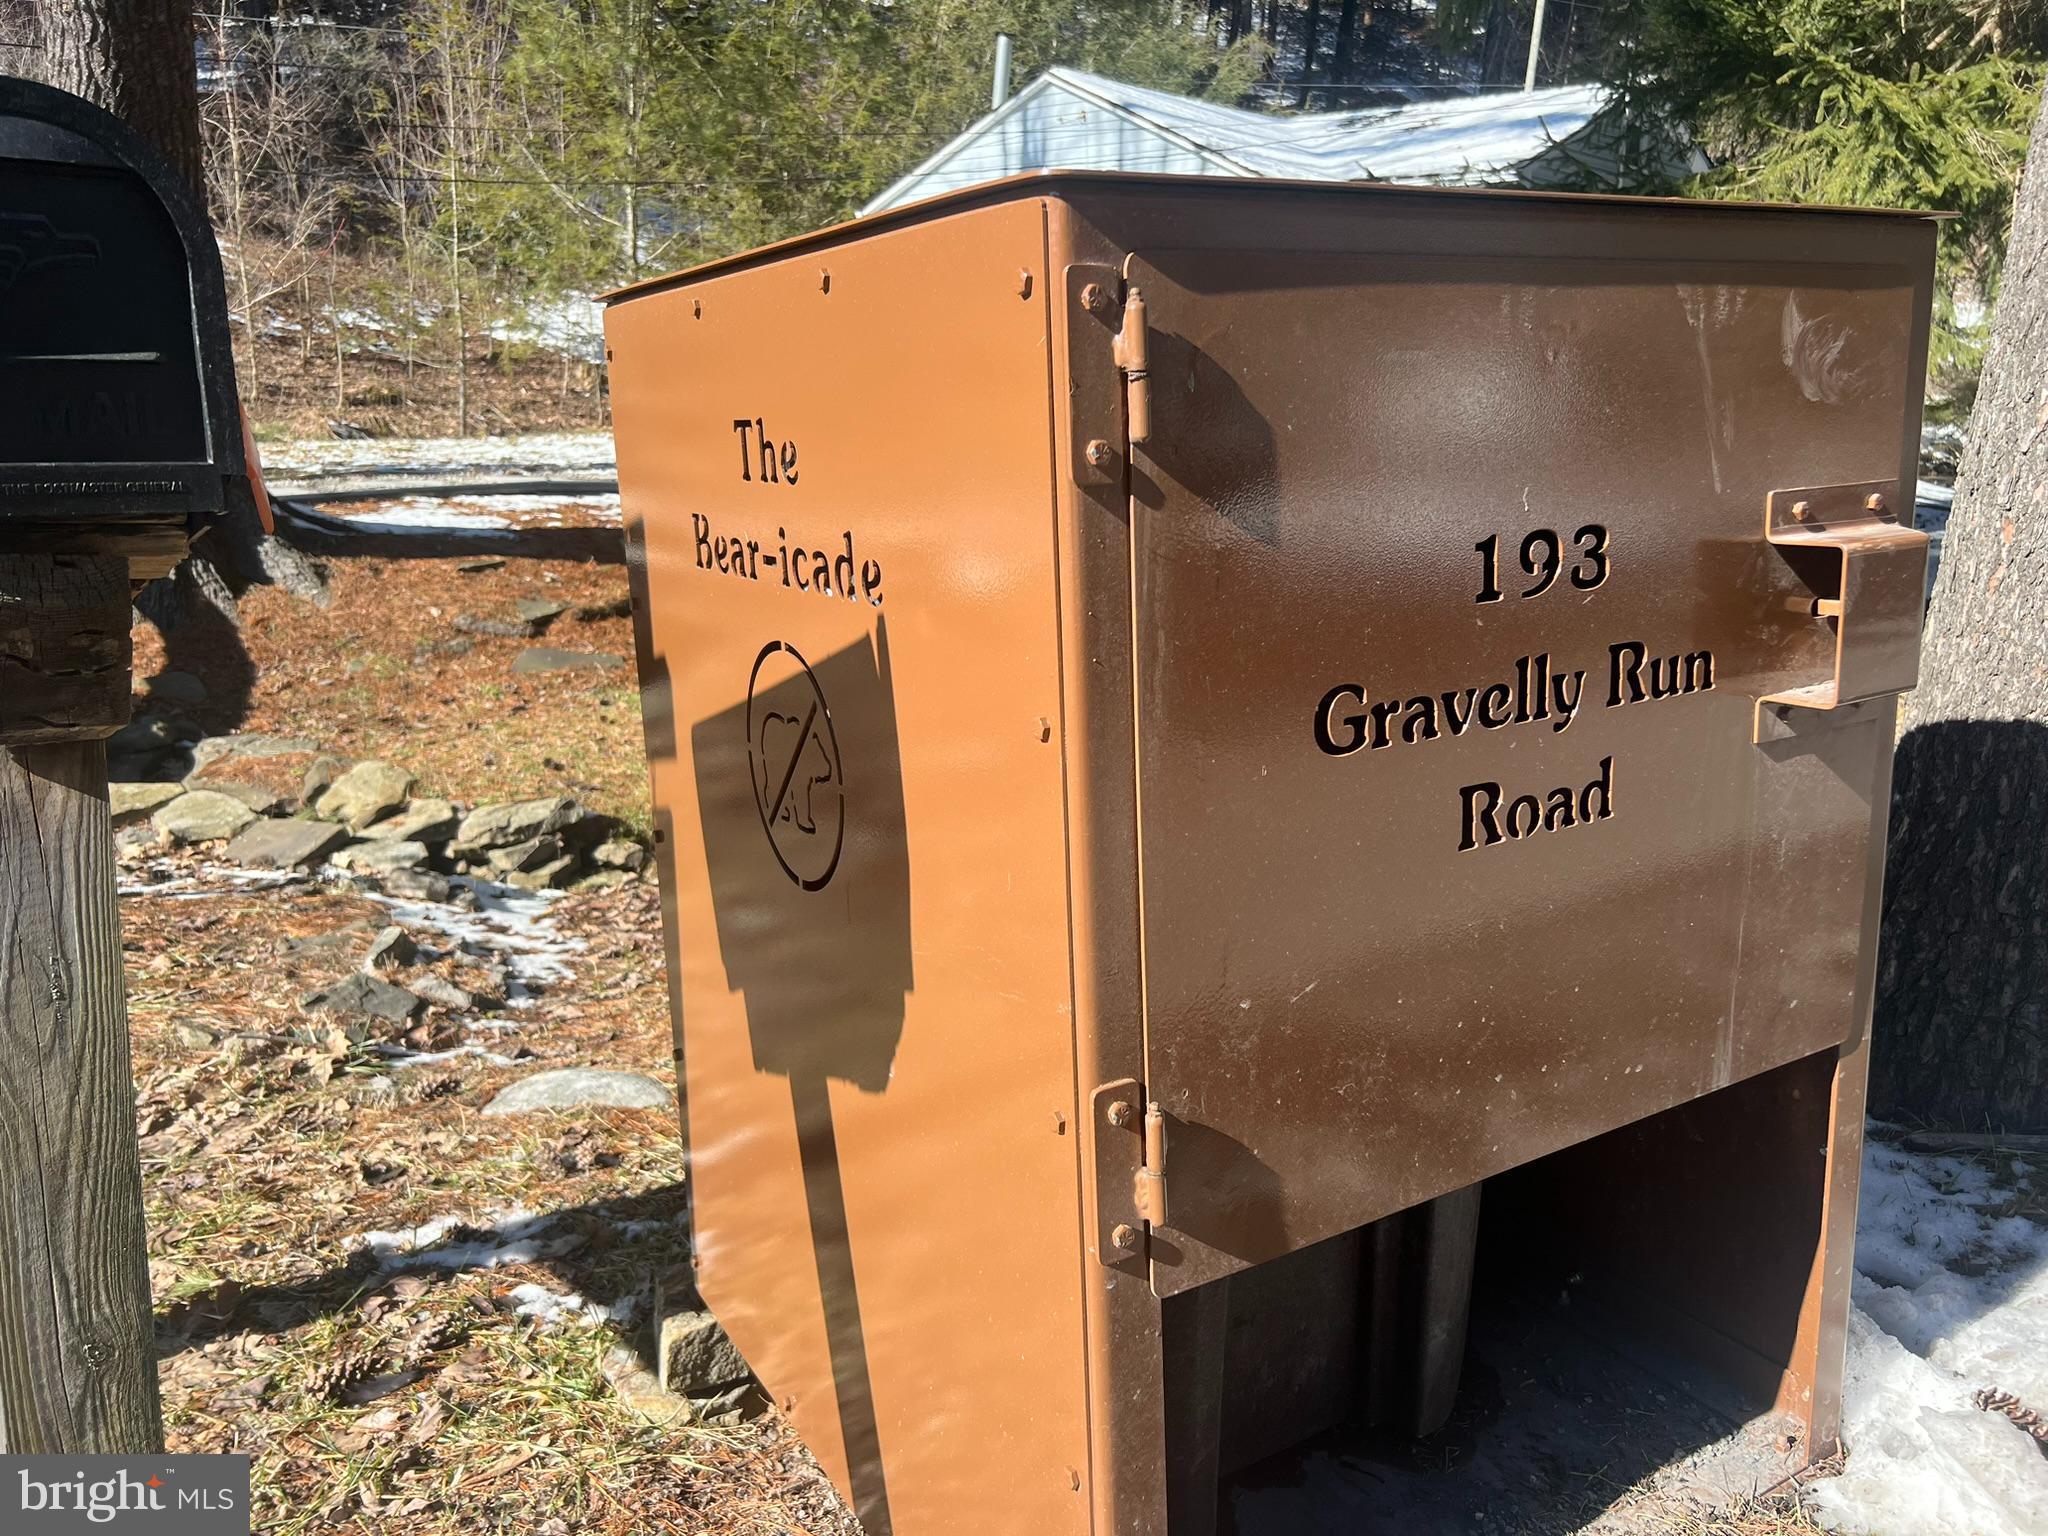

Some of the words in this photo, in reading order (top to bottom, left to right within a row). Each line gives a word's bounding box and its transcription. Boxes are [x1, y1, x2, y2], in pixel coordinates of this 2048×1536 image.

[126, 480, 185, 493] GENERAL
[733, 417, 799, 485] The
[692, 513, 883, 607] Bear-icade
[1474, 524, 1611, 605] 193
[1313, 652, 1587, 758] Gravelly
[1606, 641, 1716, 708] Run
[1458, 756, 1614, 852] Road
